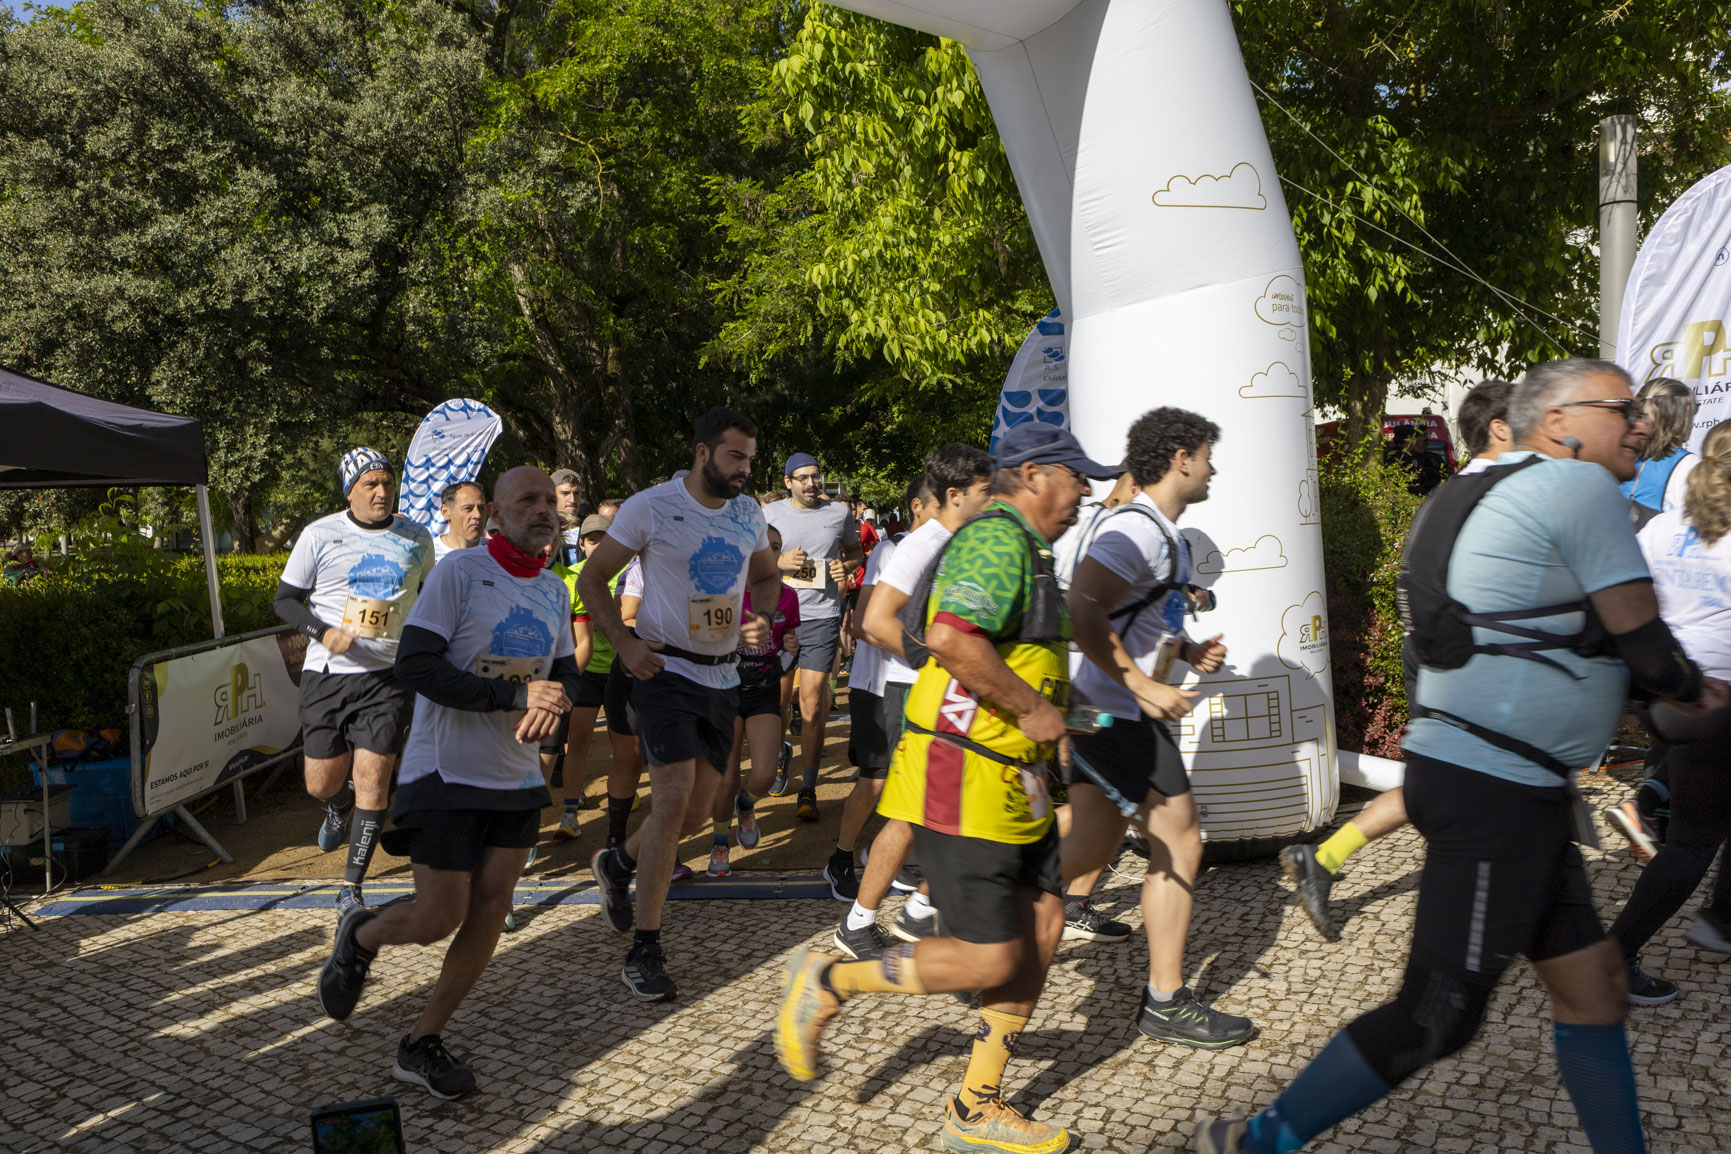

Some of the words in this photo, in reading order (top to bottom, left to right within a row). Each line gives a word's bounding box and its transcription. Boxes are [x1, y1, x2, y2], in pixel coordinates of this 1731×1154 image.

[1272, 303, 1290, 313] para
[792, 567, 817, 579] 250
[359, 608, 389, 627] 151
[703, 607, 733, 626] 190
[214, 714, 263, 743] IMOBILIÁRIA
[150, 772, 178, 789] ESTAMOS
[179, 767, 193, 778] AQUI
[193, 762, 203, 772] POR
